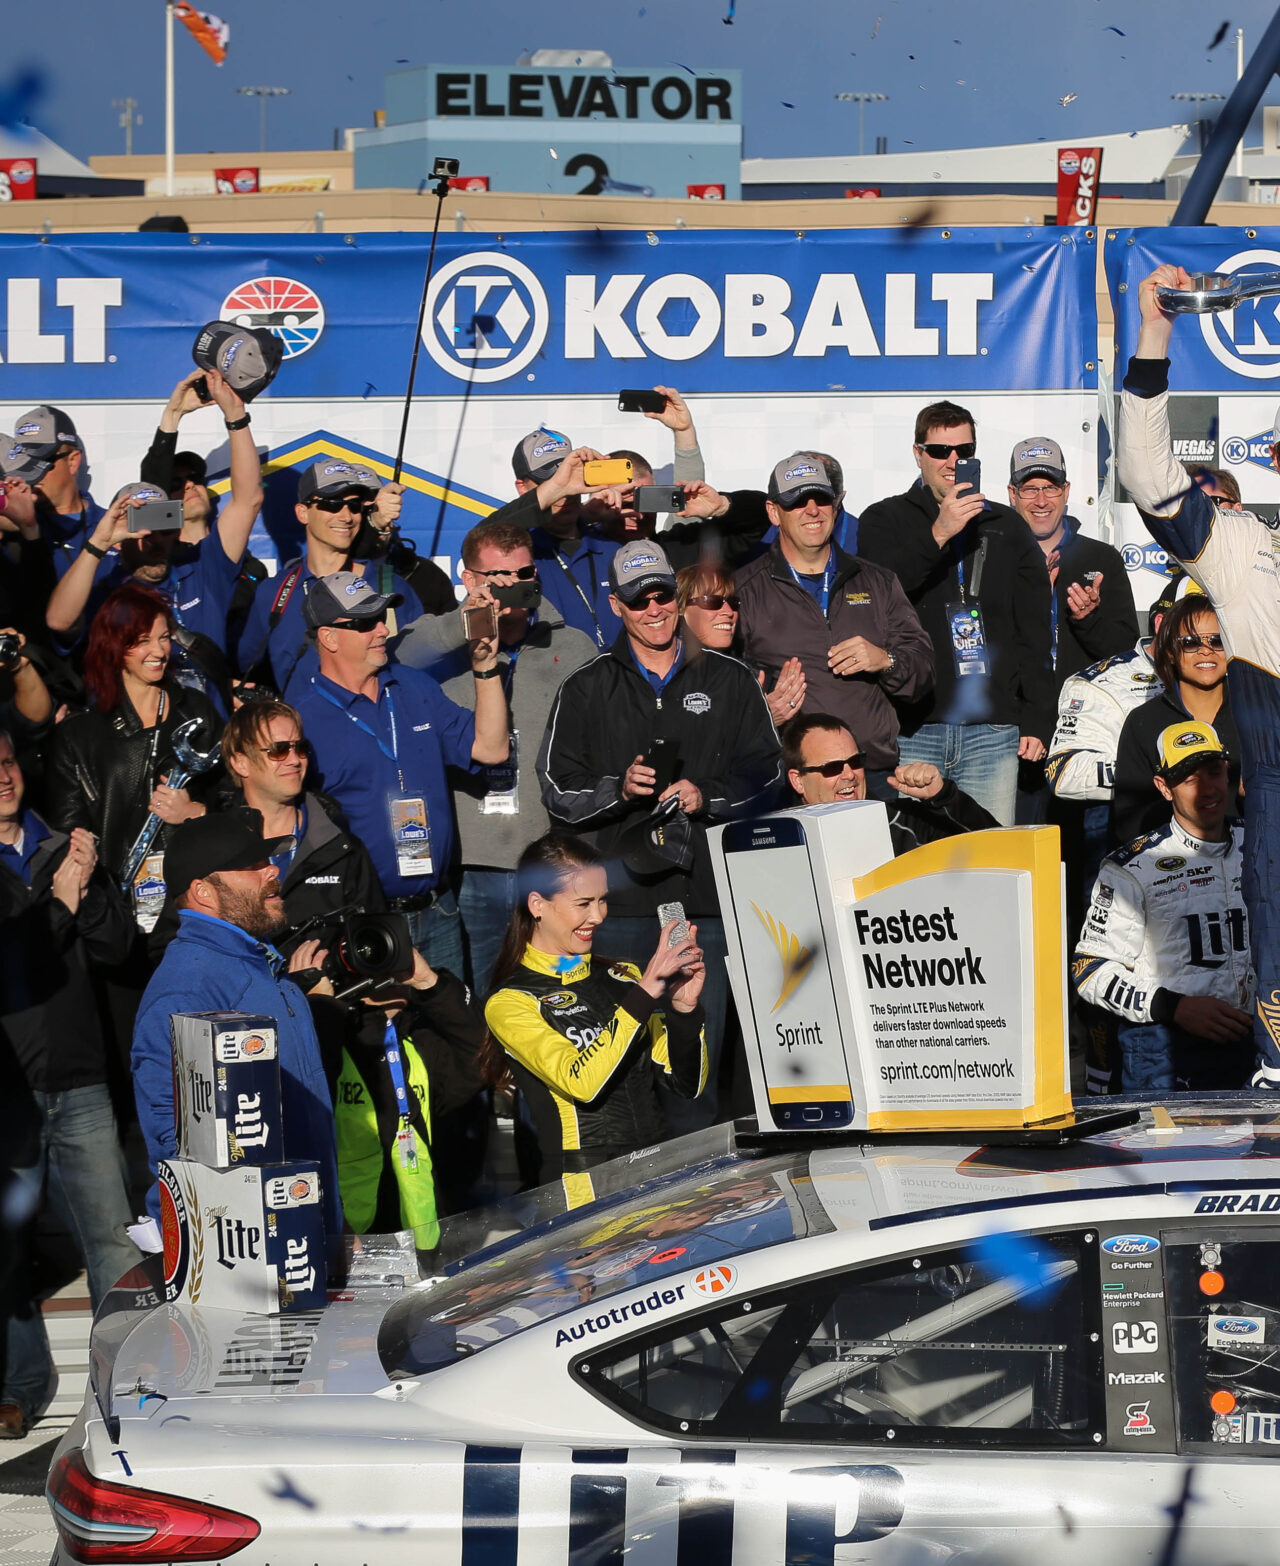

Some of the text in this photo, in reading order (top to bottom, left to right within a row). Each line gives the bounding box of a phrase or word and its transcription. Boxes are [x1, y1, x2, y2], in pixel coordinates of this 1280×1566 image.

[435, 73, 733, 121] ELEVATOR
[563, 154, 609, 195] 2
[0, 277, 123, 363] LT
[564, 272, 994, 360] KOBALT
[1172, 439, 1216, 455] VEGAS
[401, 830, 426, 840] LOWE'S
[751, 836, 776, 846] SAMSUNG
[1186, 866, 1214, 878] SKF
[138, 885, 166, 898] LOWE'S
[853, 906, 958, 946] Fastest
[1181, 907, 1249, 970] Lit
[565, 966, 586, 979] Sprint
[861, 946, 986, 990] Network
[1103, 972, 1147, 1012] Lite
[869, 1001, 985, 1017] The Sprint LTE Plus Network
[776, 1021, 823, 1052] Sprint
[873, 1017, 1007, 1032] delivers faster download speeds
[223, 1034, 241, 1061] Lite
[875, 1035, 990, 1049] than other national carriers.
[569, 1038, 606, 1080] print
[880, 1057, 1015, 1085] sprint.com/network
[187, 1069, 213, 1124] Lite
[235, 1092, 270, 1149] Lite
[158, 1161, 187, 1226] PILSNER
[272, 1179, 289, 1207] Lite
[204, 1205, 230, 1229] Miller
[213, 1215, 261, 1271] Lite
[1111, 1238, 1151, 1254] Ford
[284, 1236, 317, 1293] Lite
[1111, 1261, 1153, 1270] Go Further
[1103, 1291, 1164, 1301] Hewlett Packard
[1103, 1299, 1141, 1308] Enterprise
[554, 1282, 687, 1349] Autotrader
[1221, 1319, 1252, 1333] Ford
[1114, 1322, 1157, 1349] PPG
[1108, 1371, 1167, 1386] Mazak
